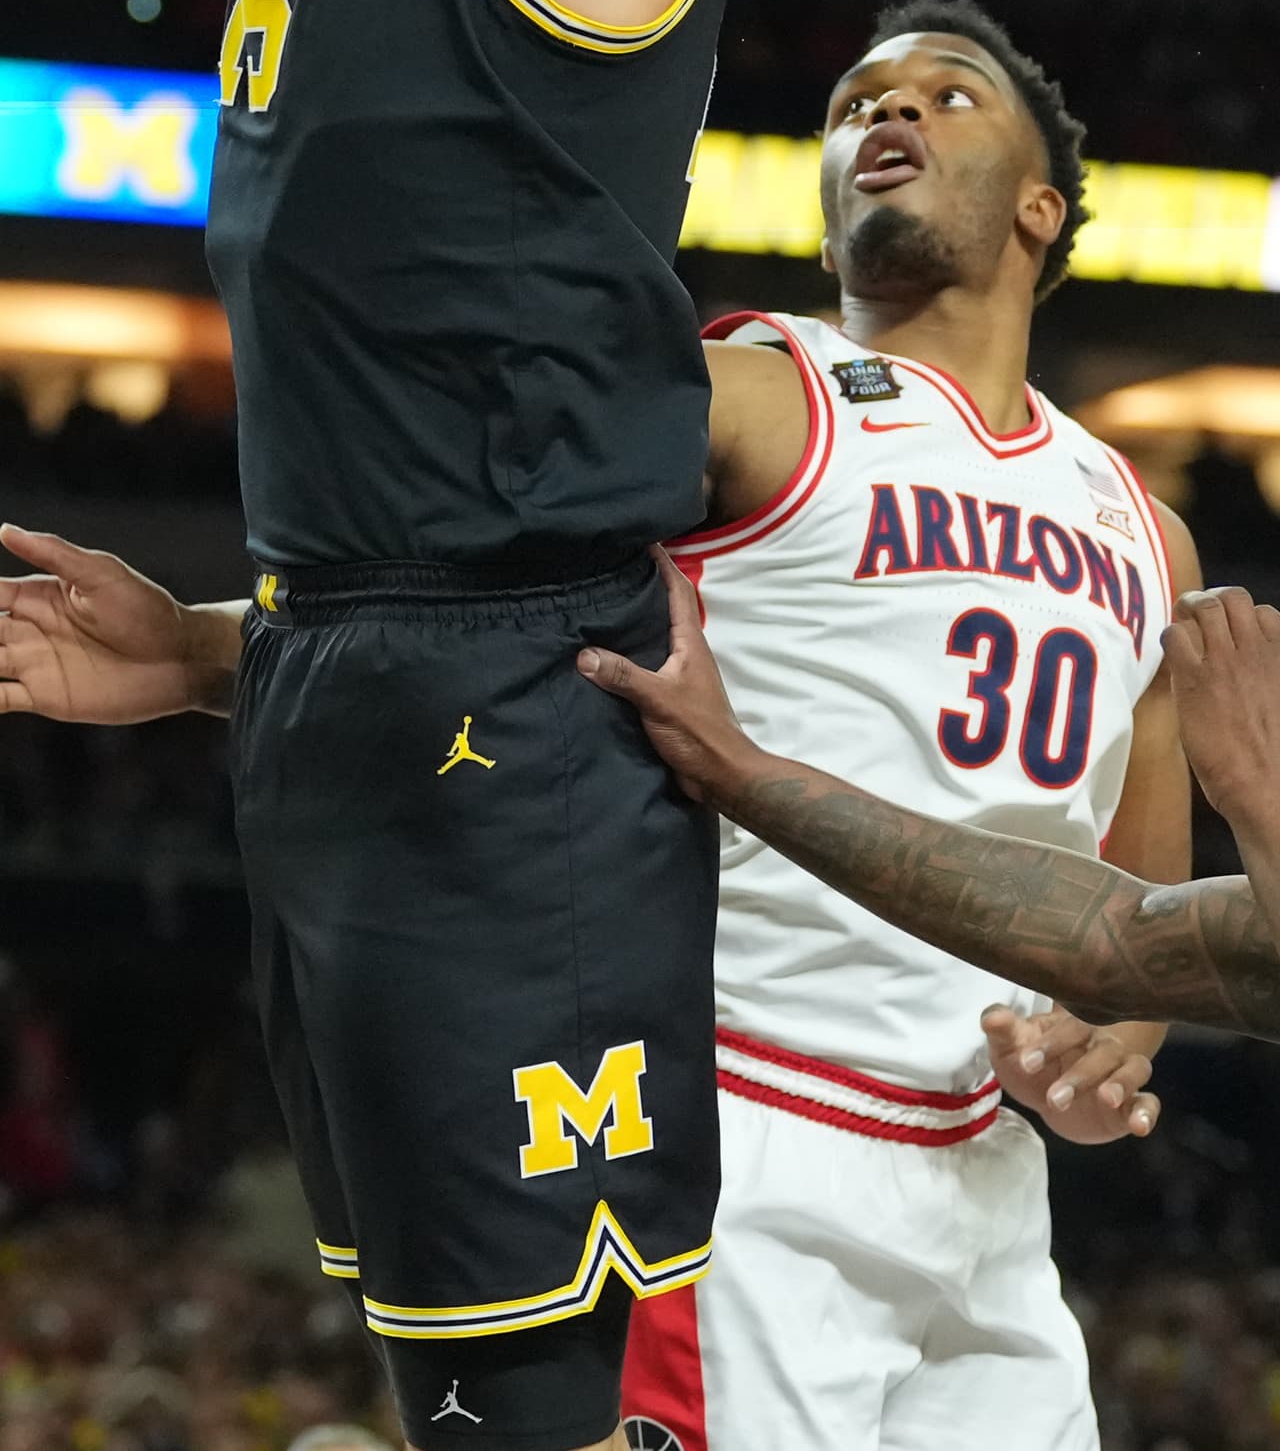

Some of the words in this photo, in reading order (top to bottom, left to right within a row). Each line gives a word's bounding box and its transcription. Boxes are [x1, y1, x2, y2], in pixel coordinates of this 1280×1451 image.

[839, 364, 885, 379] FINAL
[849, 381, 892, 396] FOUR
[854, 483, 1147, 662] ARIZONA
[937, 606, 1098, 791] 30
[512, 1039, 655, 1180] M
